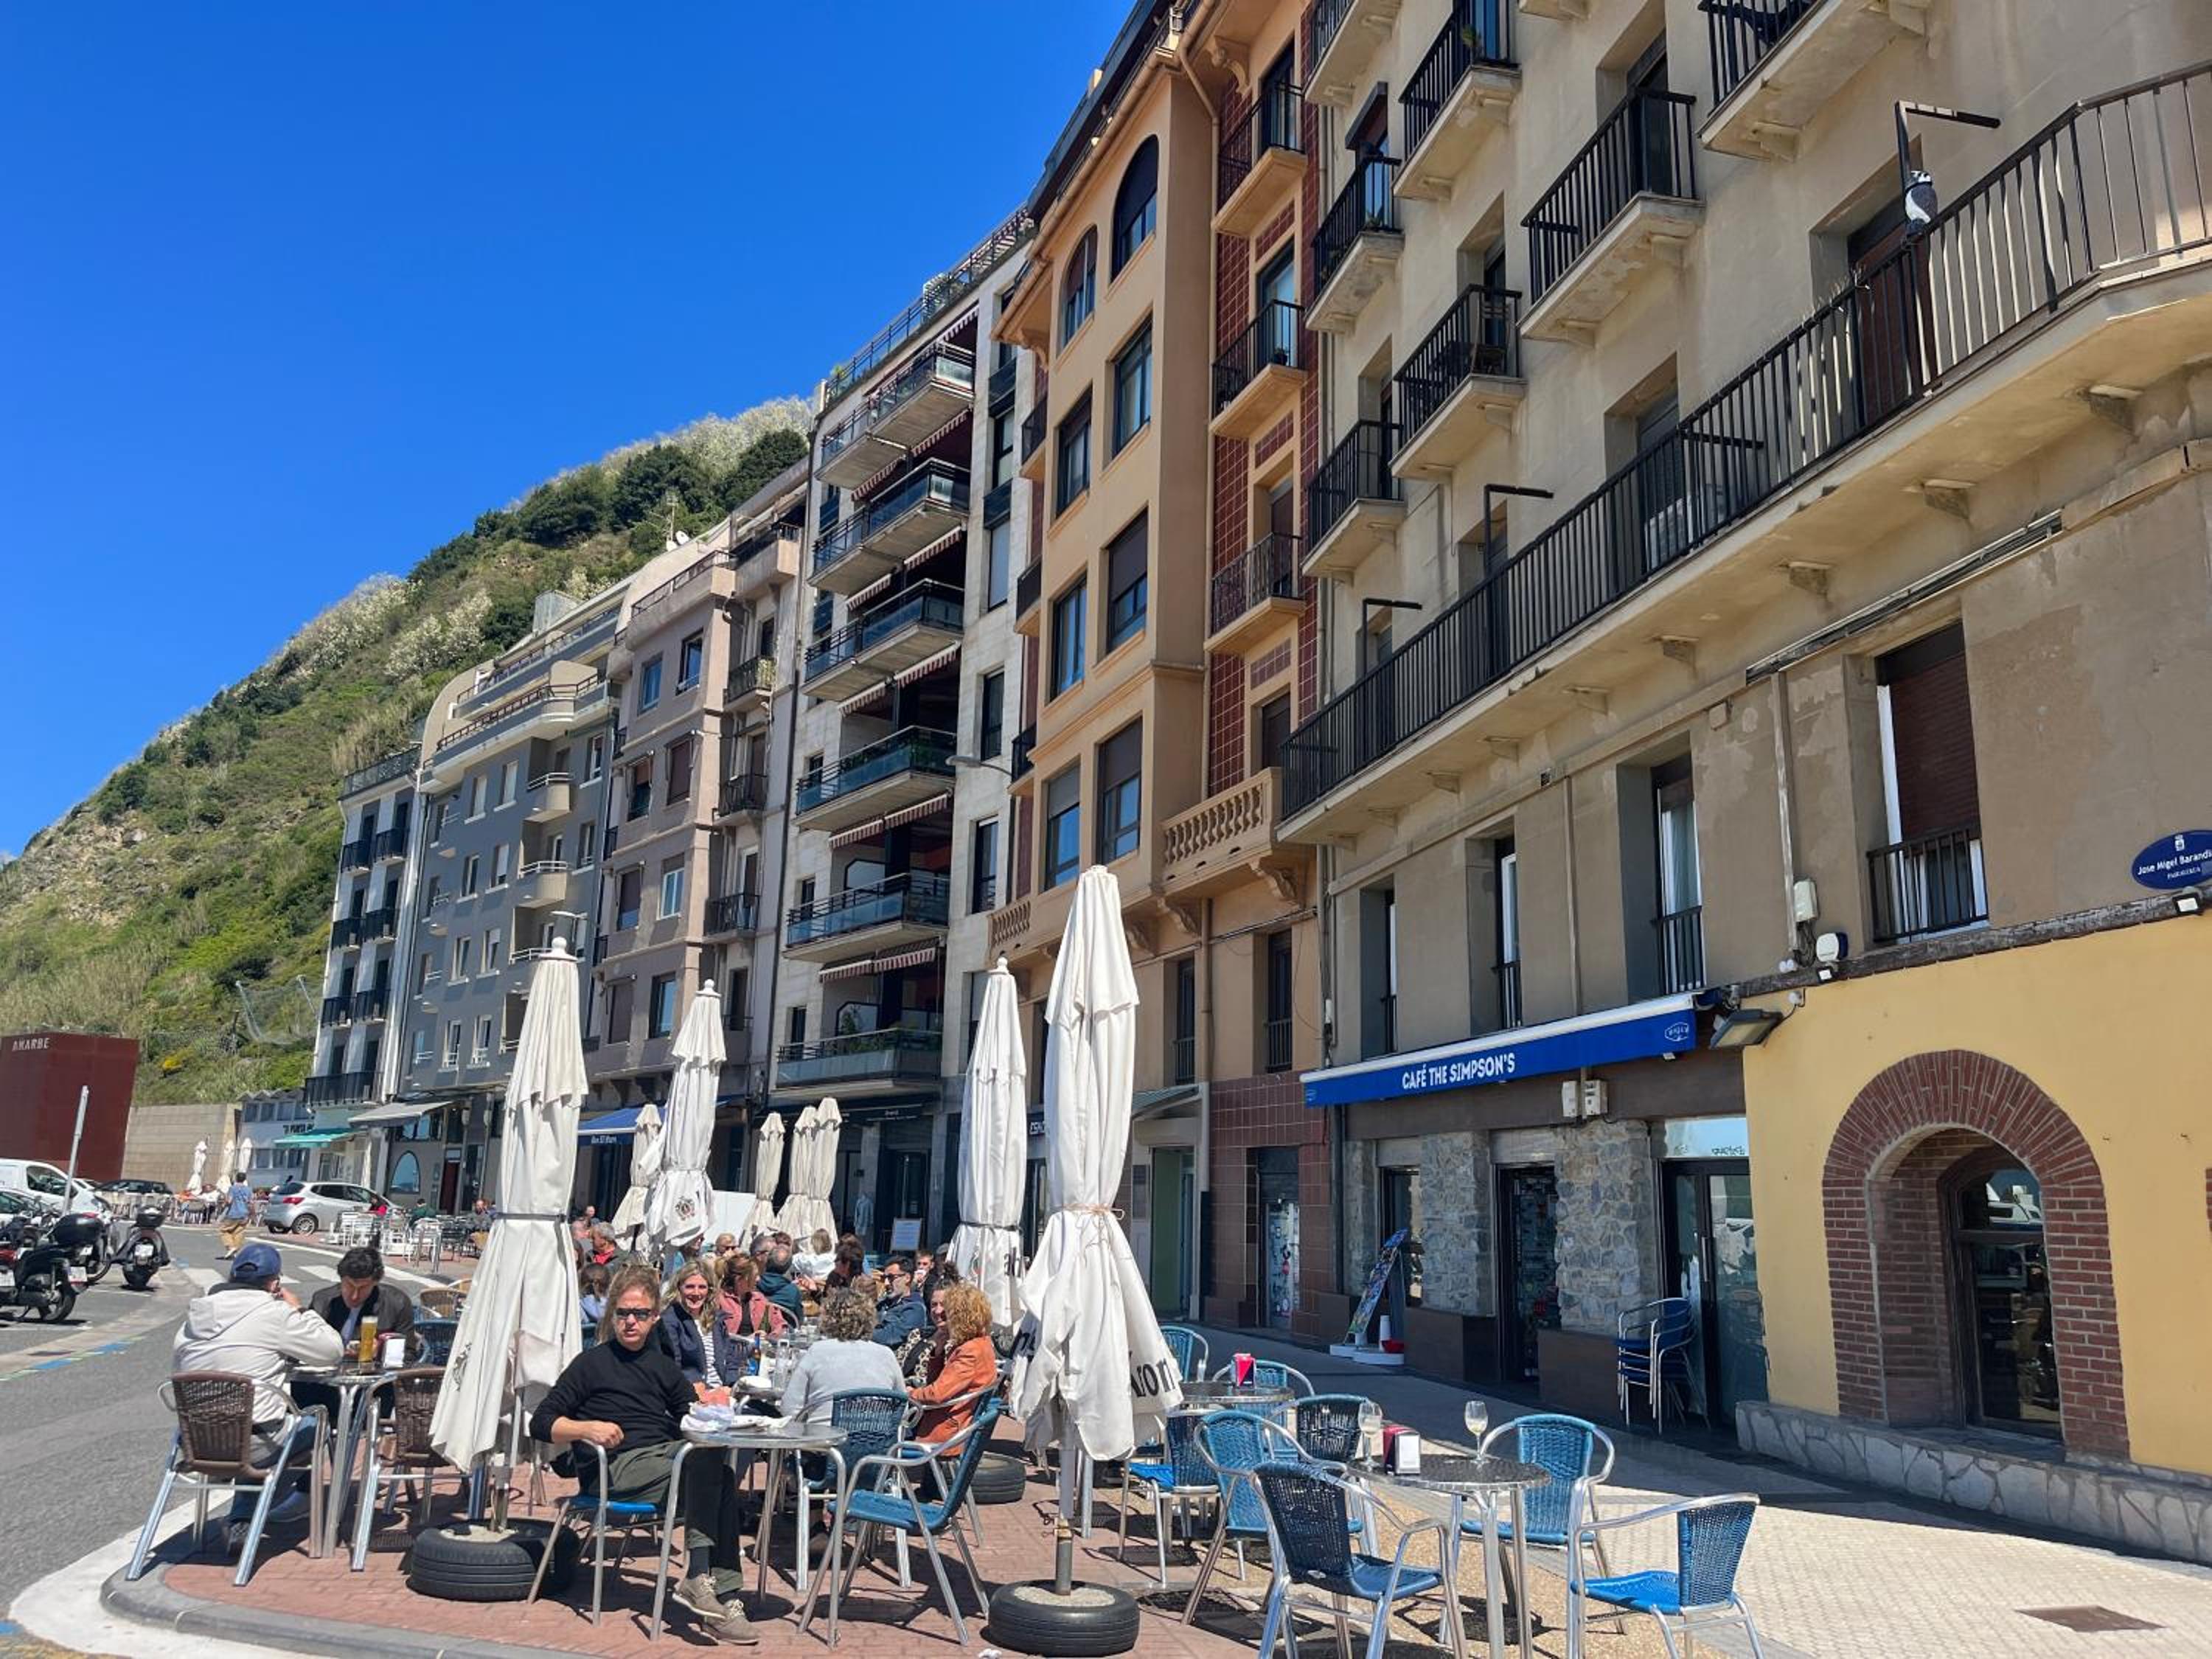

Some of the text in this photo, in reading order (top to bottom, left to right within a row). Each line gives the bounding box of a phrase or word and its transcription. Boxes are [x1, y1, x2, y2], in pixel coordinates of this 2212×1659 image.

[2138, 865, 2155, 875] Jose
[2157, 857, 2177, 870] Migel
[1402, 1052, 1515, 1089] CAFÉ THE SIMPSON'S
